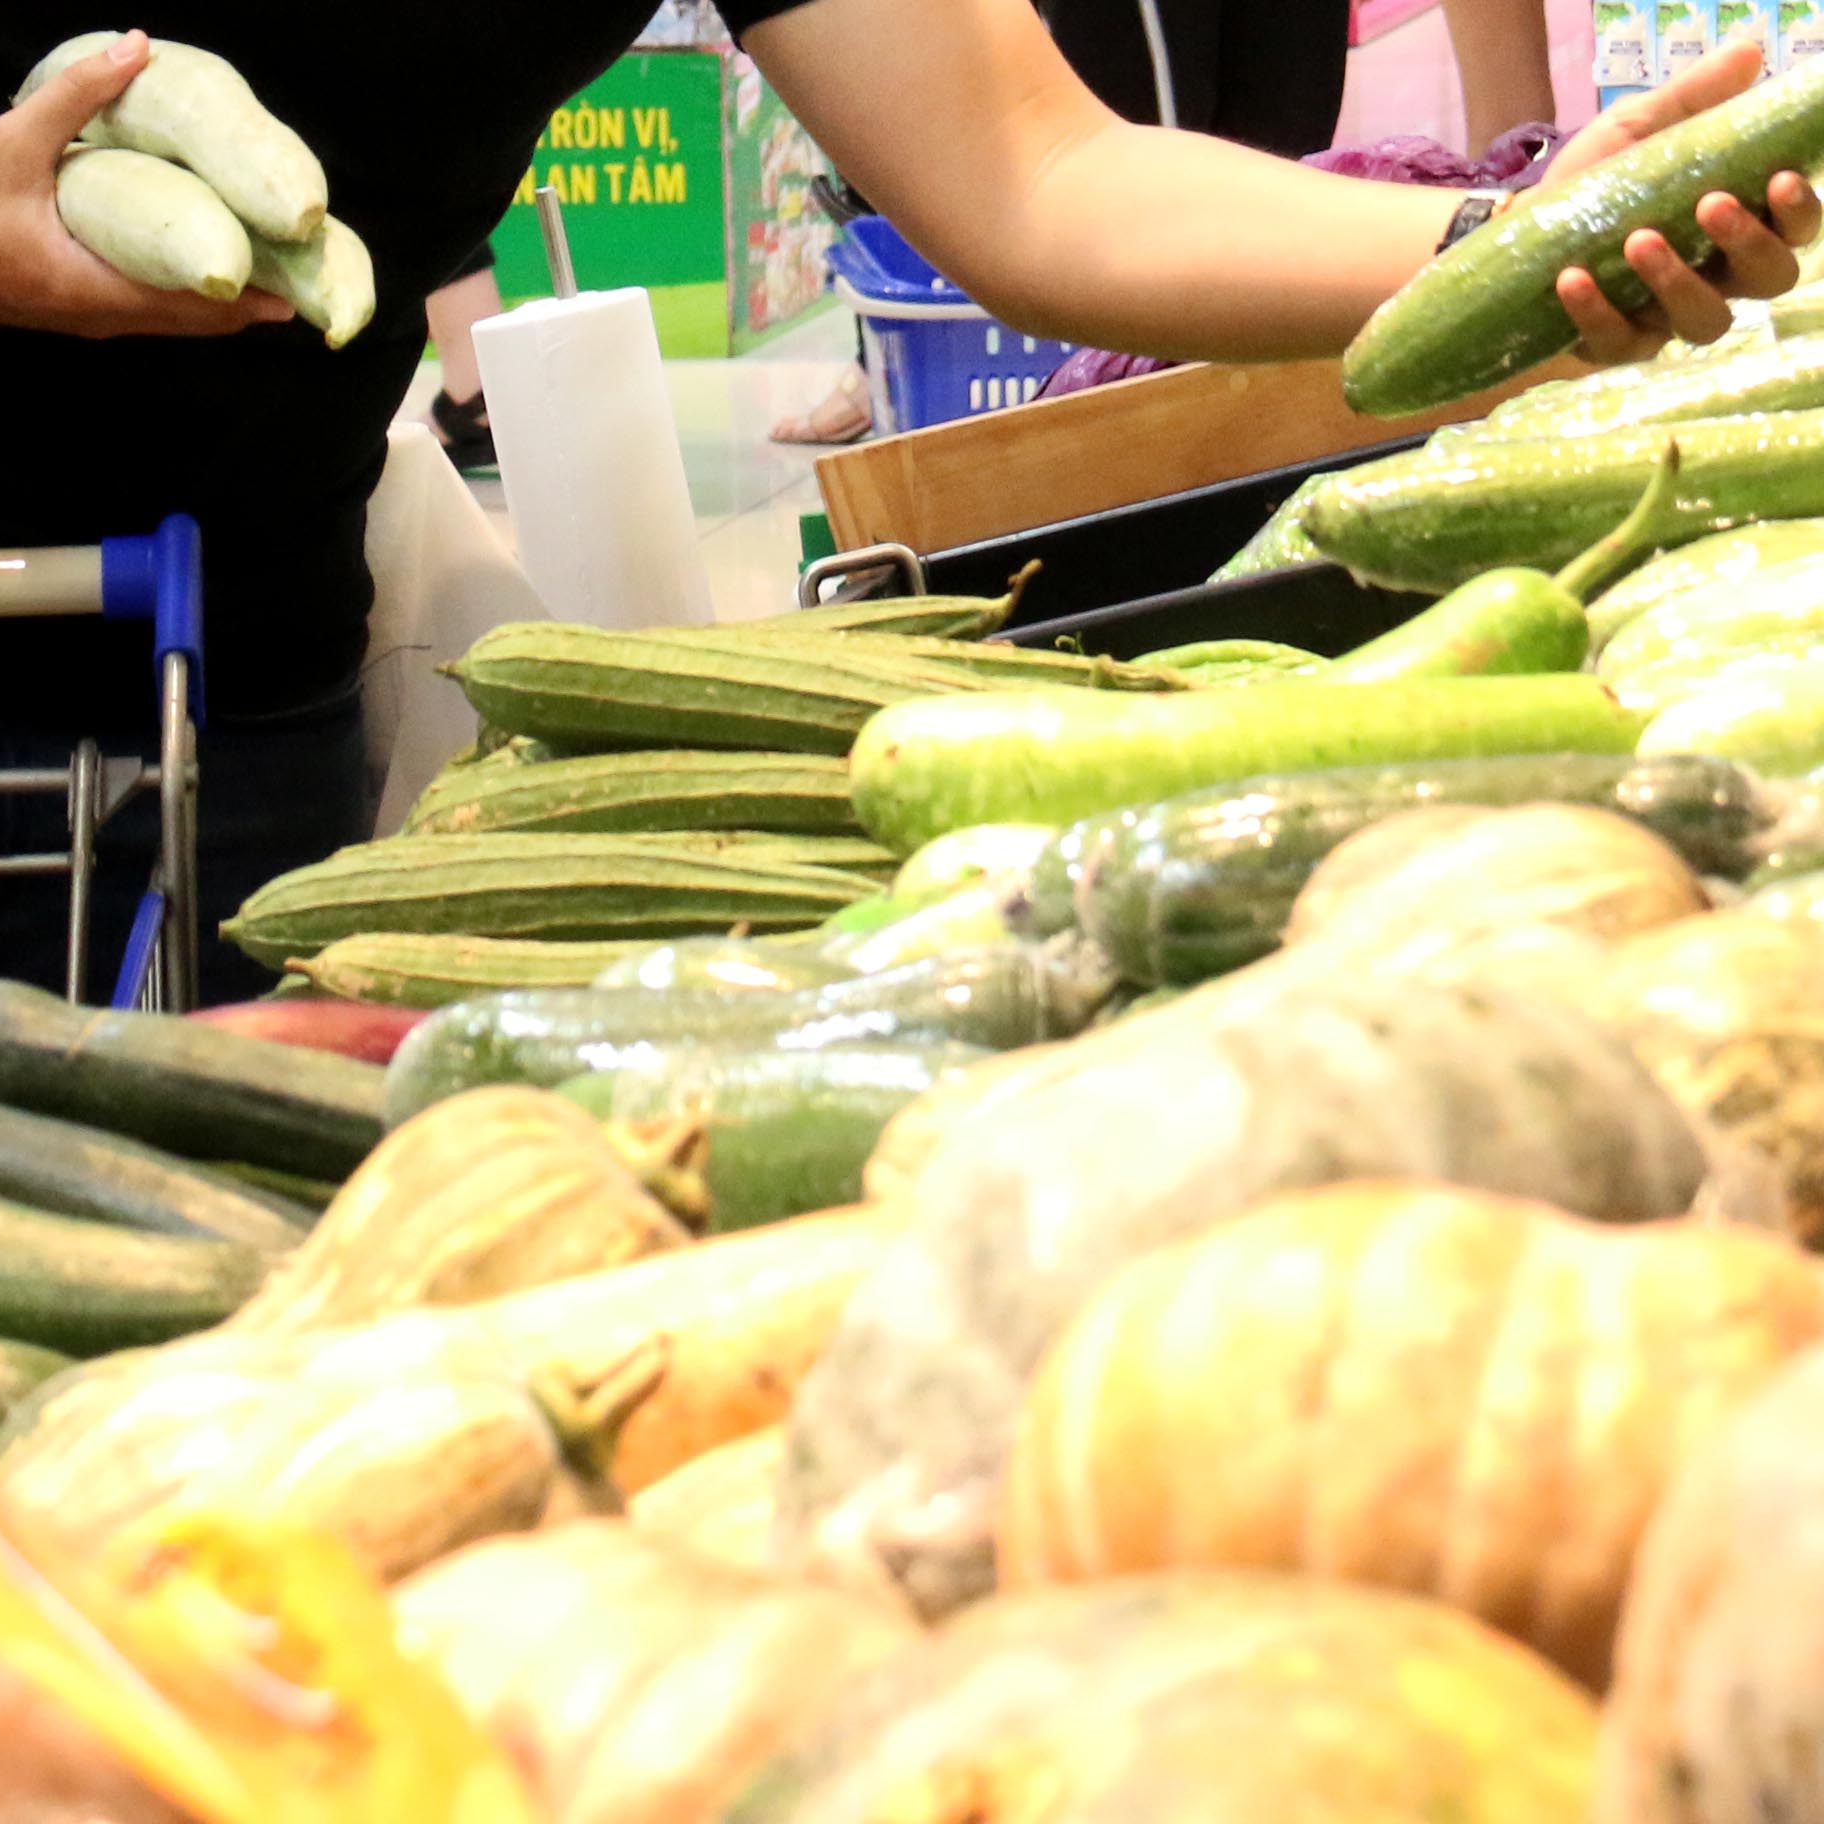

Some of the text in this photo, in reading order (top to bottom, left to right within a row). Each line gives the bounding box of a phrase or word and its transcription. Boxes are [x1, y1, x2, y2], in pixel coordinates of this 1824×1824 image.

[631, 107, 679, 156] VỊ,
[547, 155, 687, 205] AN TÂM
